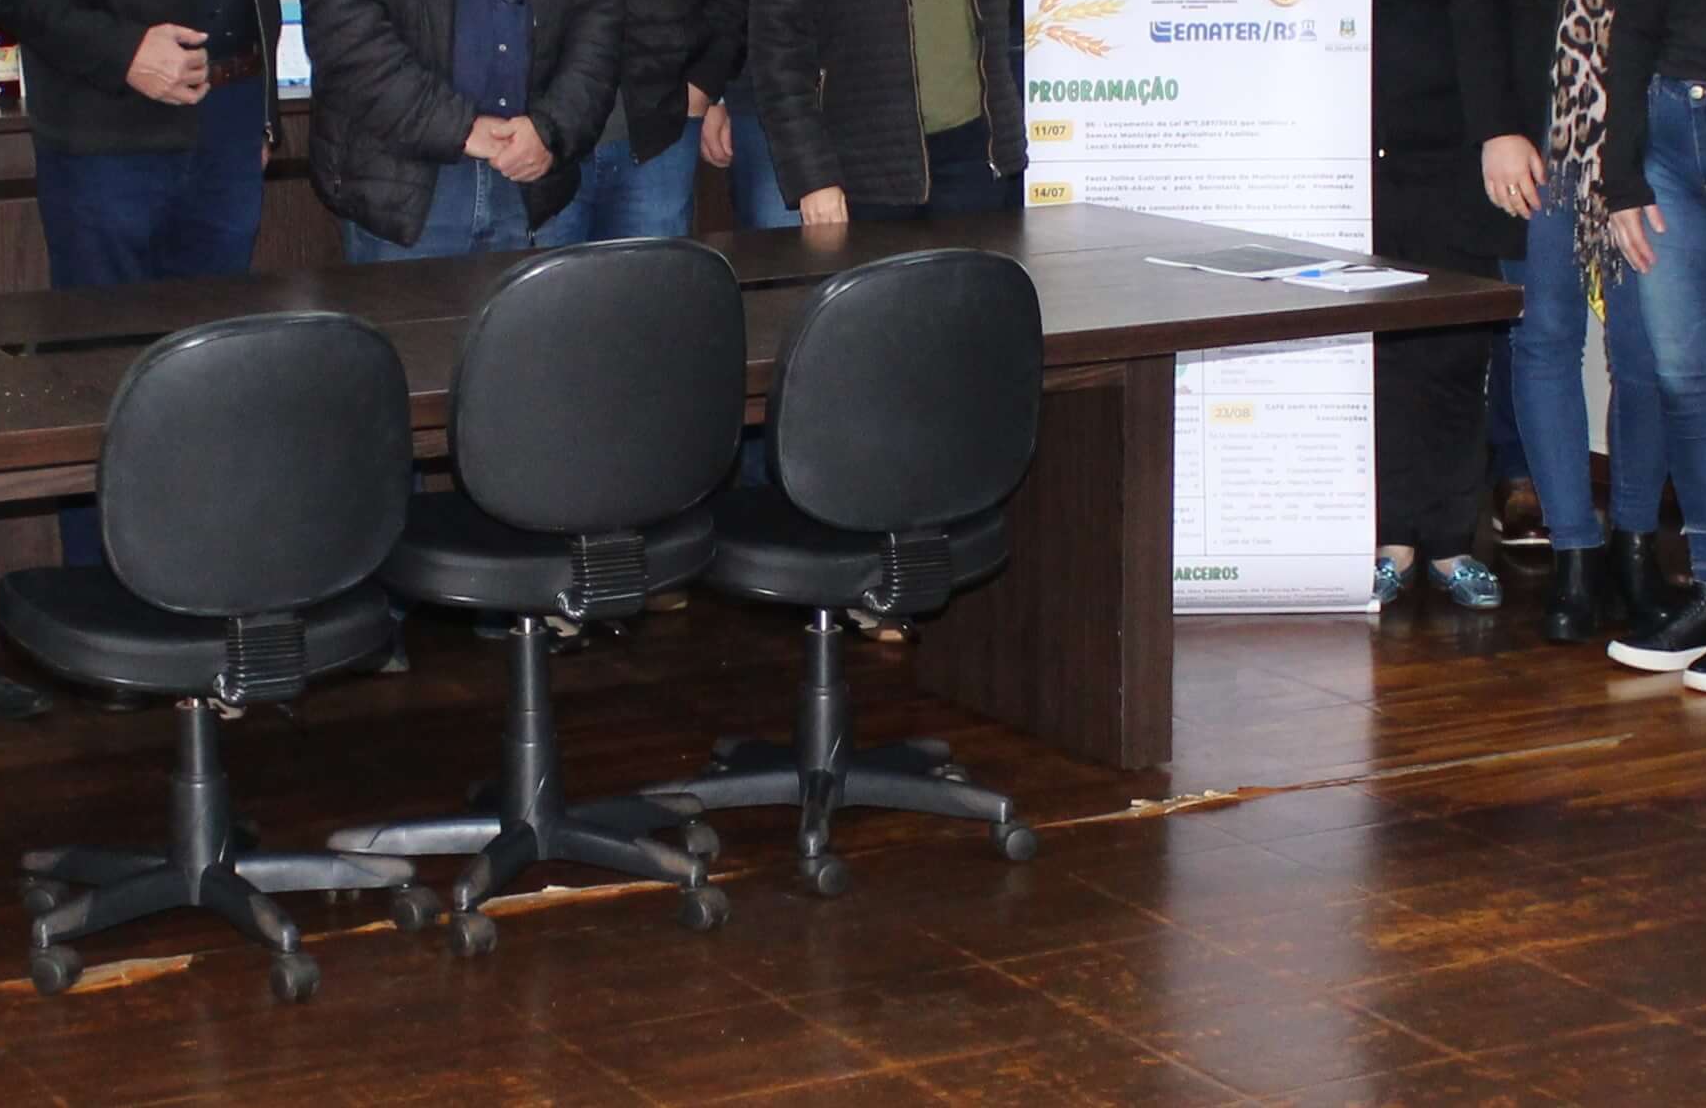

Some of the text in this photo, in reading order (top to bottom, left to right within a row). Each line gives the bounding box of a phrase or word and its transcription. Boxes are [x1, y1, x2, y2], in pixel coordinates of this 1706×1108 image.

[1173, 20, 1297, 43] EMATER/RS
[1028, 75, 1180, 106] PROGRAMAÇÃO
[1034, 124, 1066, 137] 11/07
[1034, 187, 1066, 200] 14/07
[1214, 406, 1252, 420] 23/08
[1173, 566, 1240, 582] ARCEIROS
